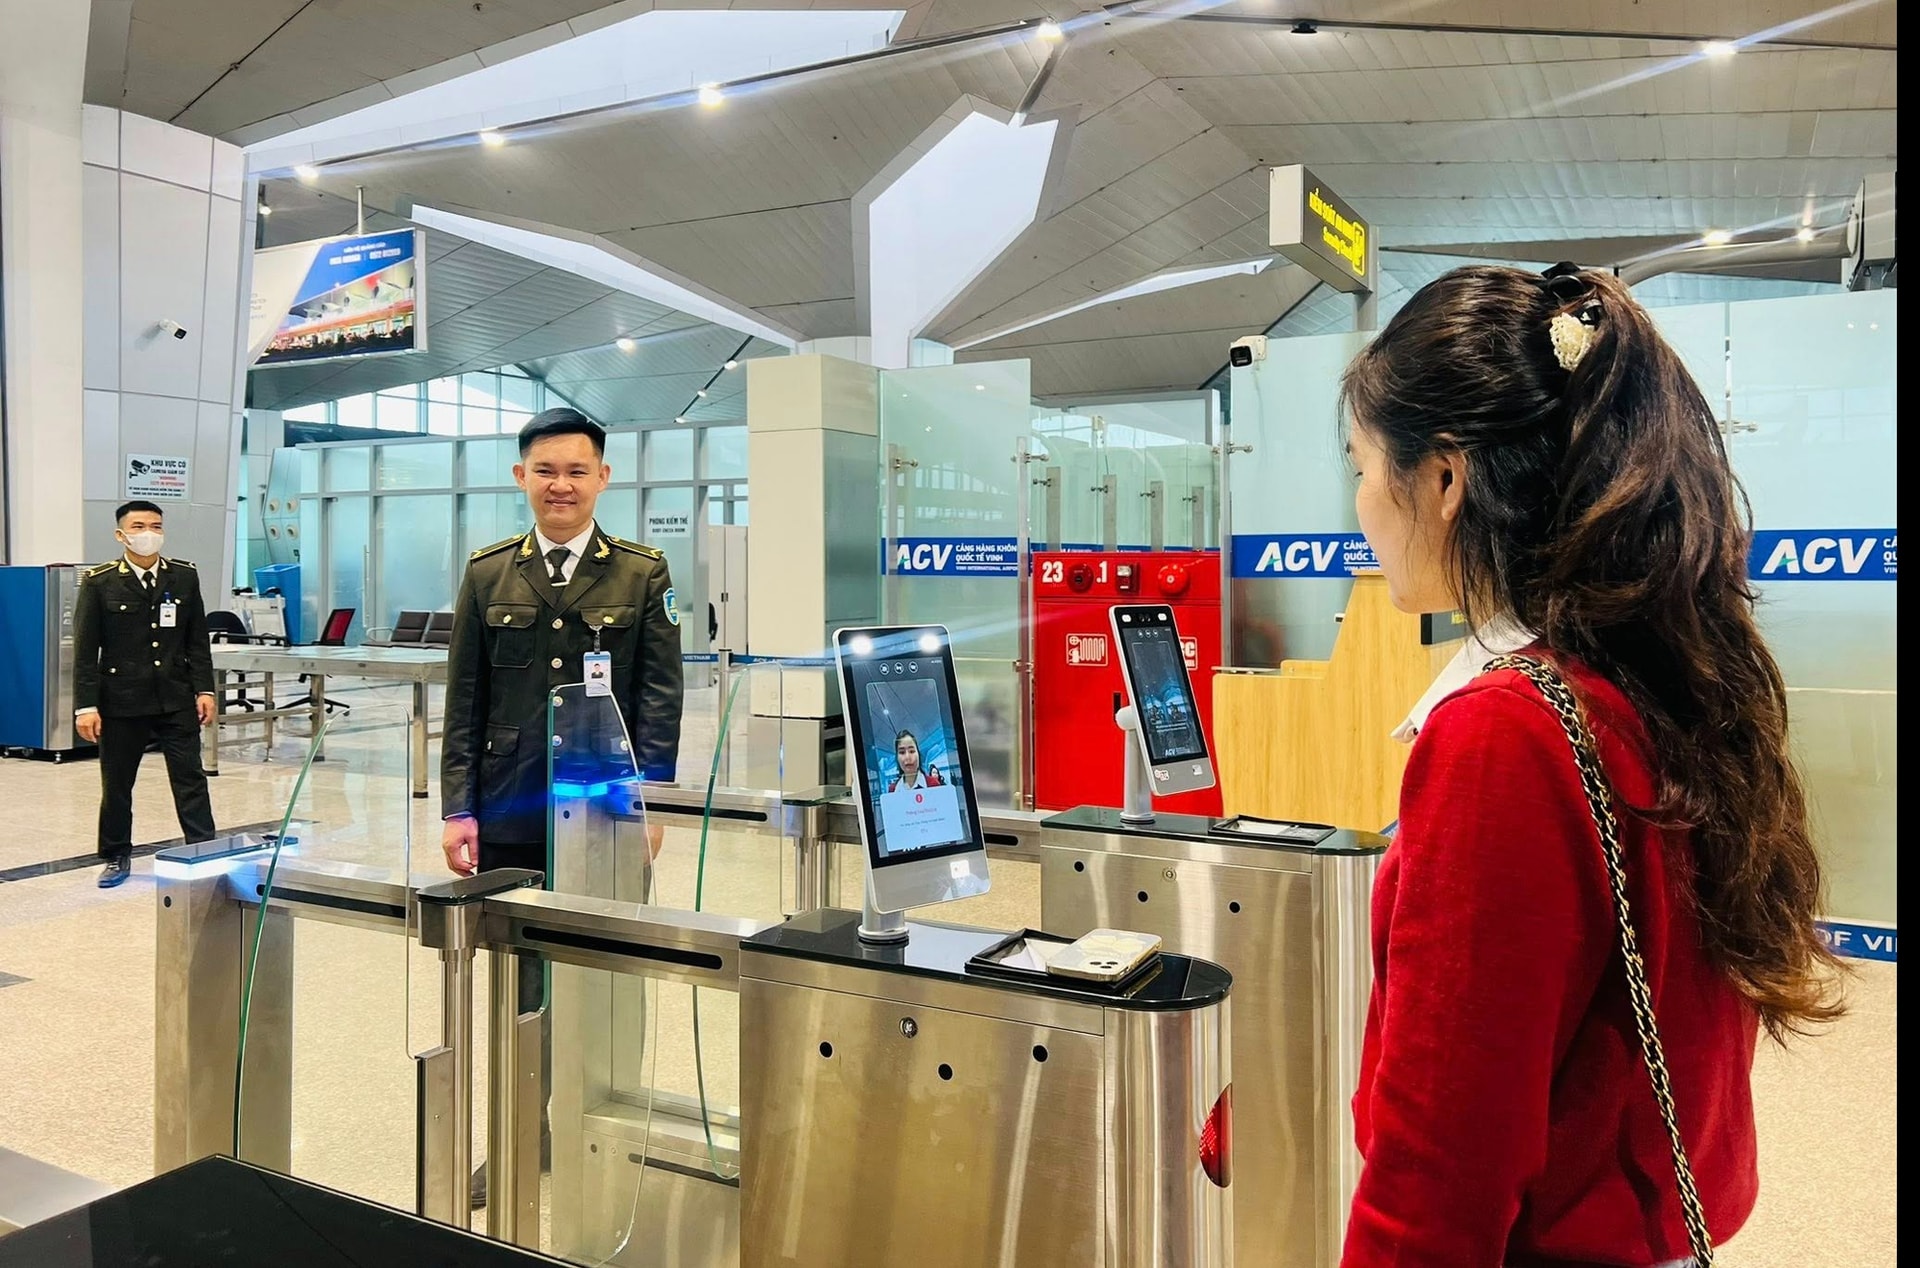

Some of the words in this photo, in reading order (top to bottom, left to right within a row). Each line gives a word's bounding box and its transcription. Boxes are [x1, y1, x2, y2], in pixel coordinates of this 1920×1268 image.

[151, 459, 163, 467] KHU
[896, 543, 953, 571] ACV
[1255, 541, 1339, 572] ACV
[1761, 538, 1878, 574] ACV
[1042, 561, 1063, 583] 23
[1862, 933, 1897, 953] VI
